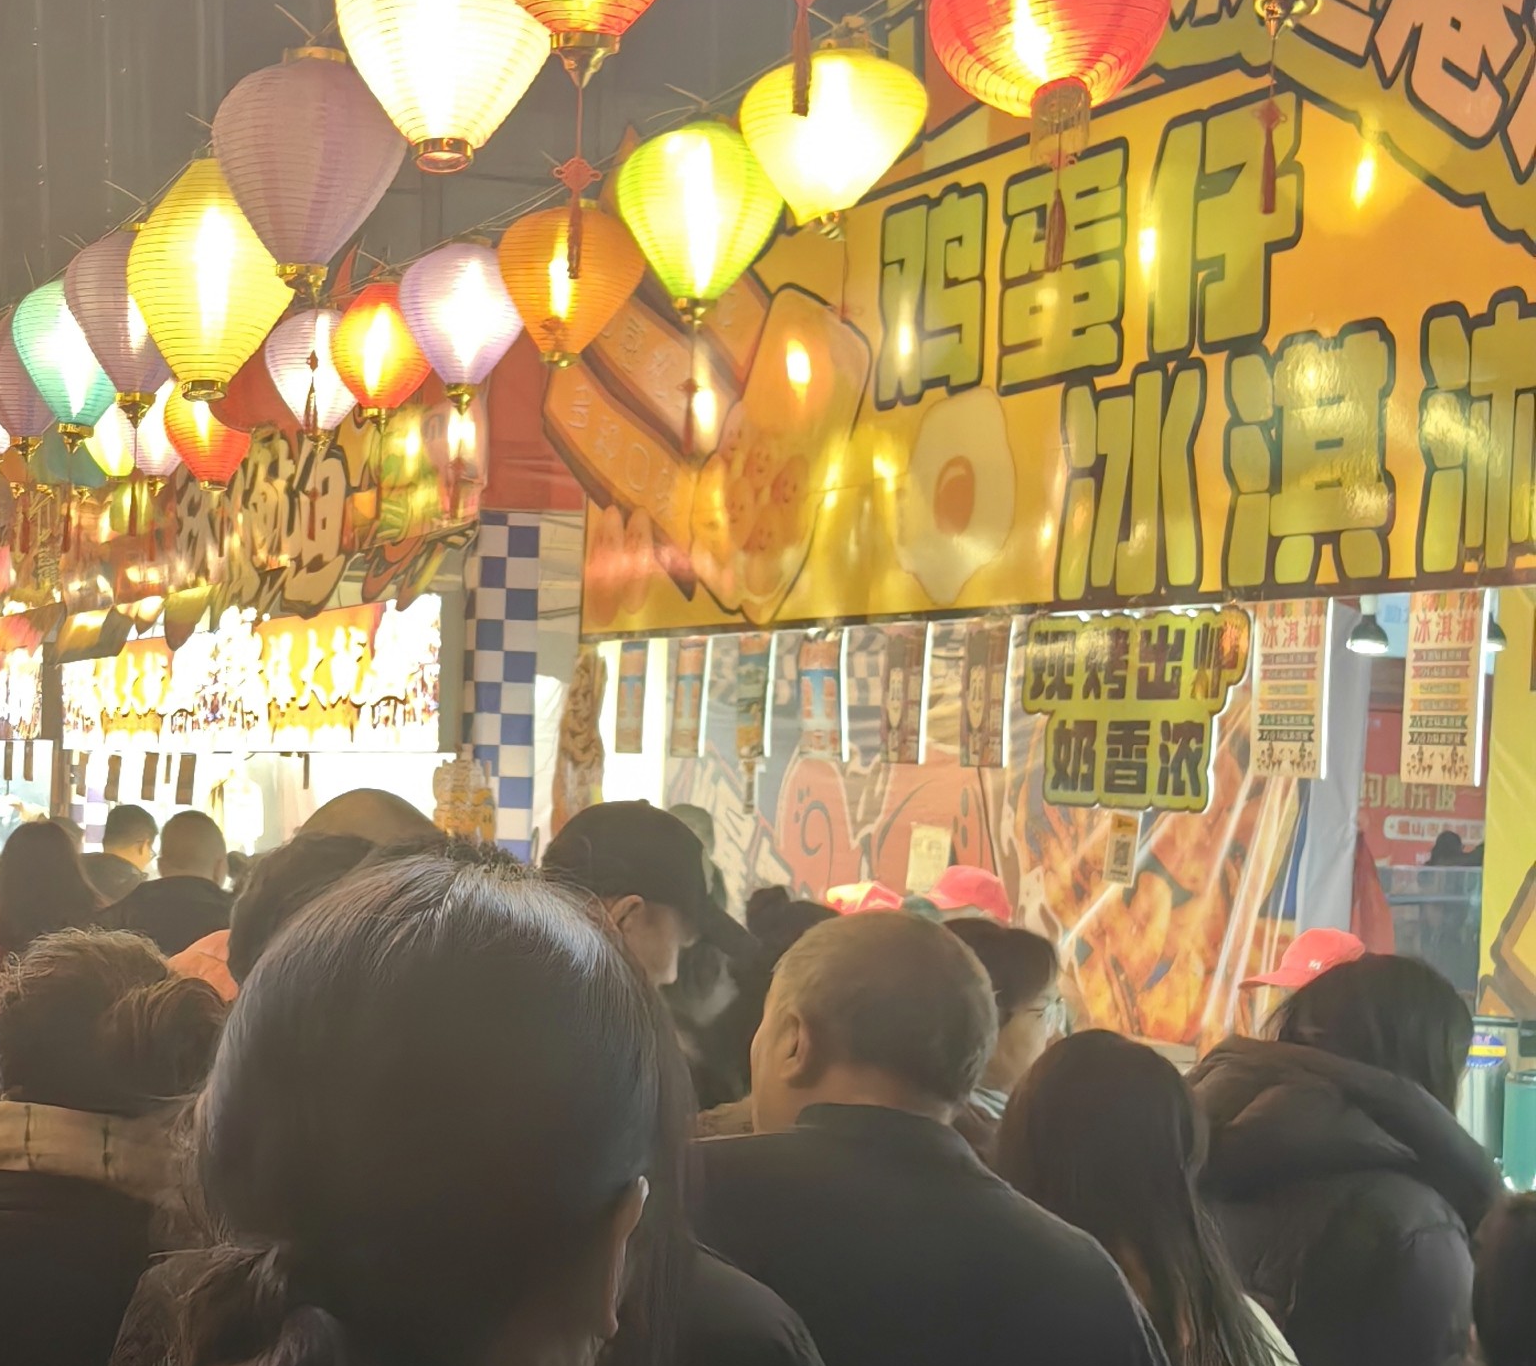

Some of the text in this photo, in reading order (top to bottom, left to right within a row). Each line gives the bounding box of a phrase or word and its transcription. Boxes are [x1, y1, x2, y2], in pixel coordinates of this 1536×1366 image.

[875, 90, 1303, 410] 鸡蛋仔
[1052, 719, 1205, 797] 奶香浓
